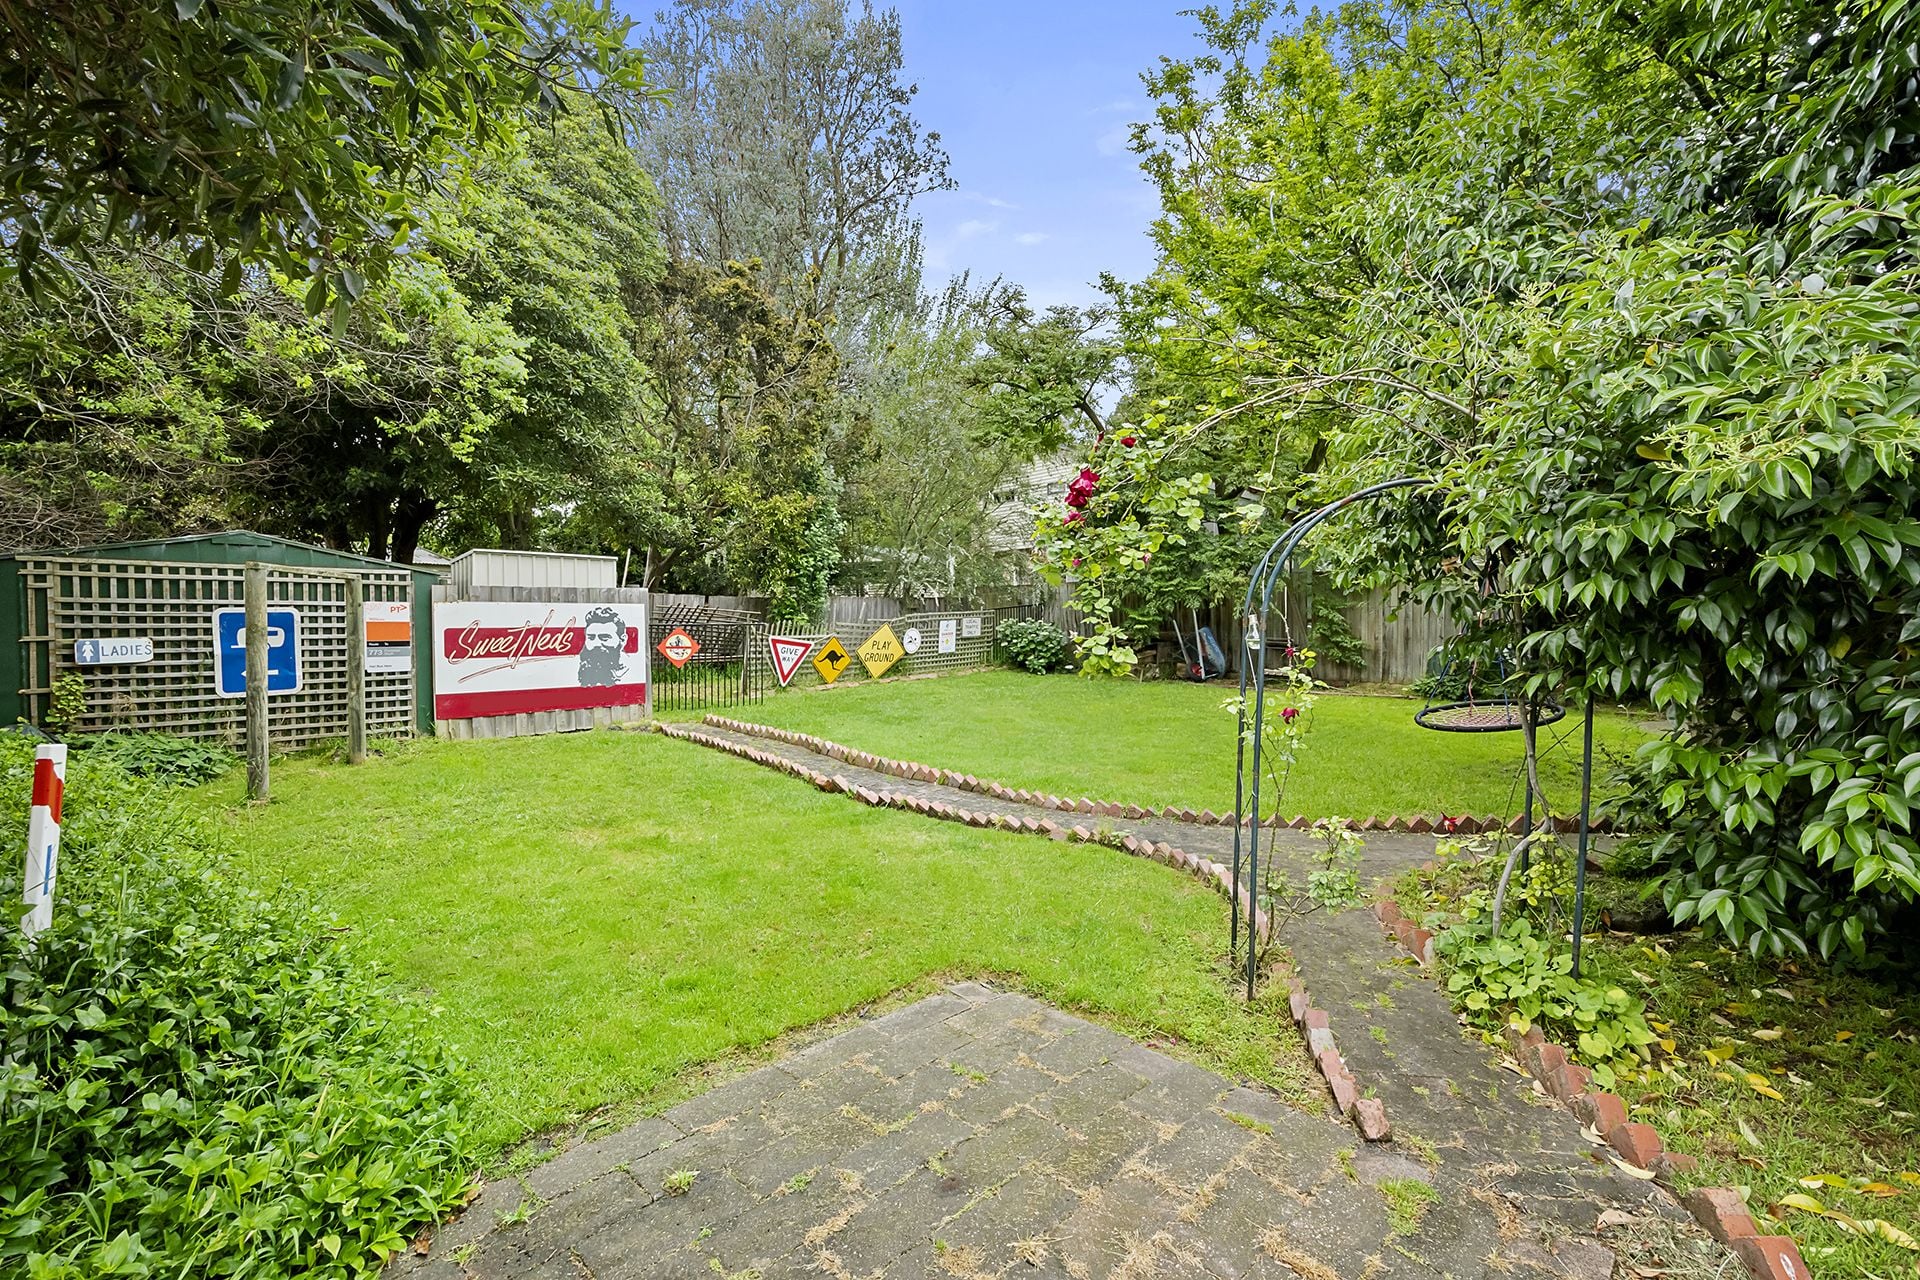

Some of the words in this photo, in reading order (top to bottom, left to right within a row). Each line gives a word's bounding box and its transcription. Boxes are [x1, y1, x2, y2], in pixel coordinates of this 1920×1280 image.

[871, 640, 892, 650] PLAY
[101, 644, 152, 657] LADIES
[780, 646, 800, 656] GIVE
[863, 652, 895, 662] GROUND
